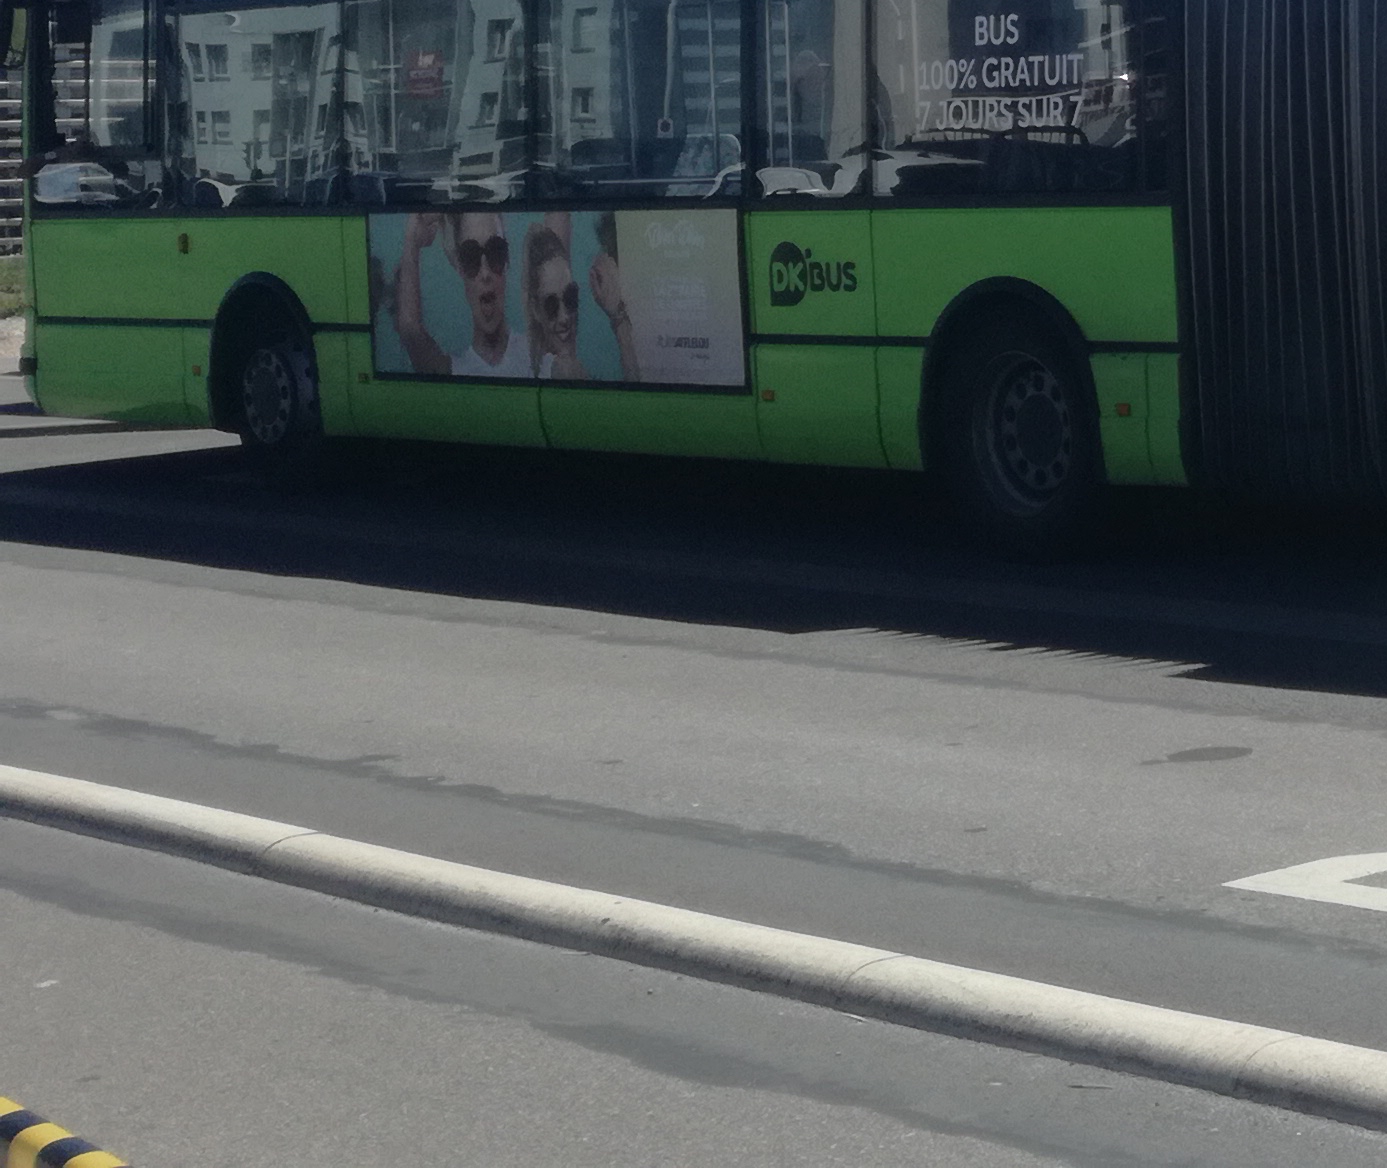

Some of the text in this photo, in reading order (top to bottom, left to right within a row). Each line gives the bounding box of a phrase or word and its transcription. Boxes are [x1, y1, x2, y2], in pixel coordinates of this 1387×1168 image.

[974, 13, 1019, 46] BUS
[918, 54, 1084, 91] 100% GRATUIT
[917, 96, 1087, 130] 7 JOURS SUR 7
